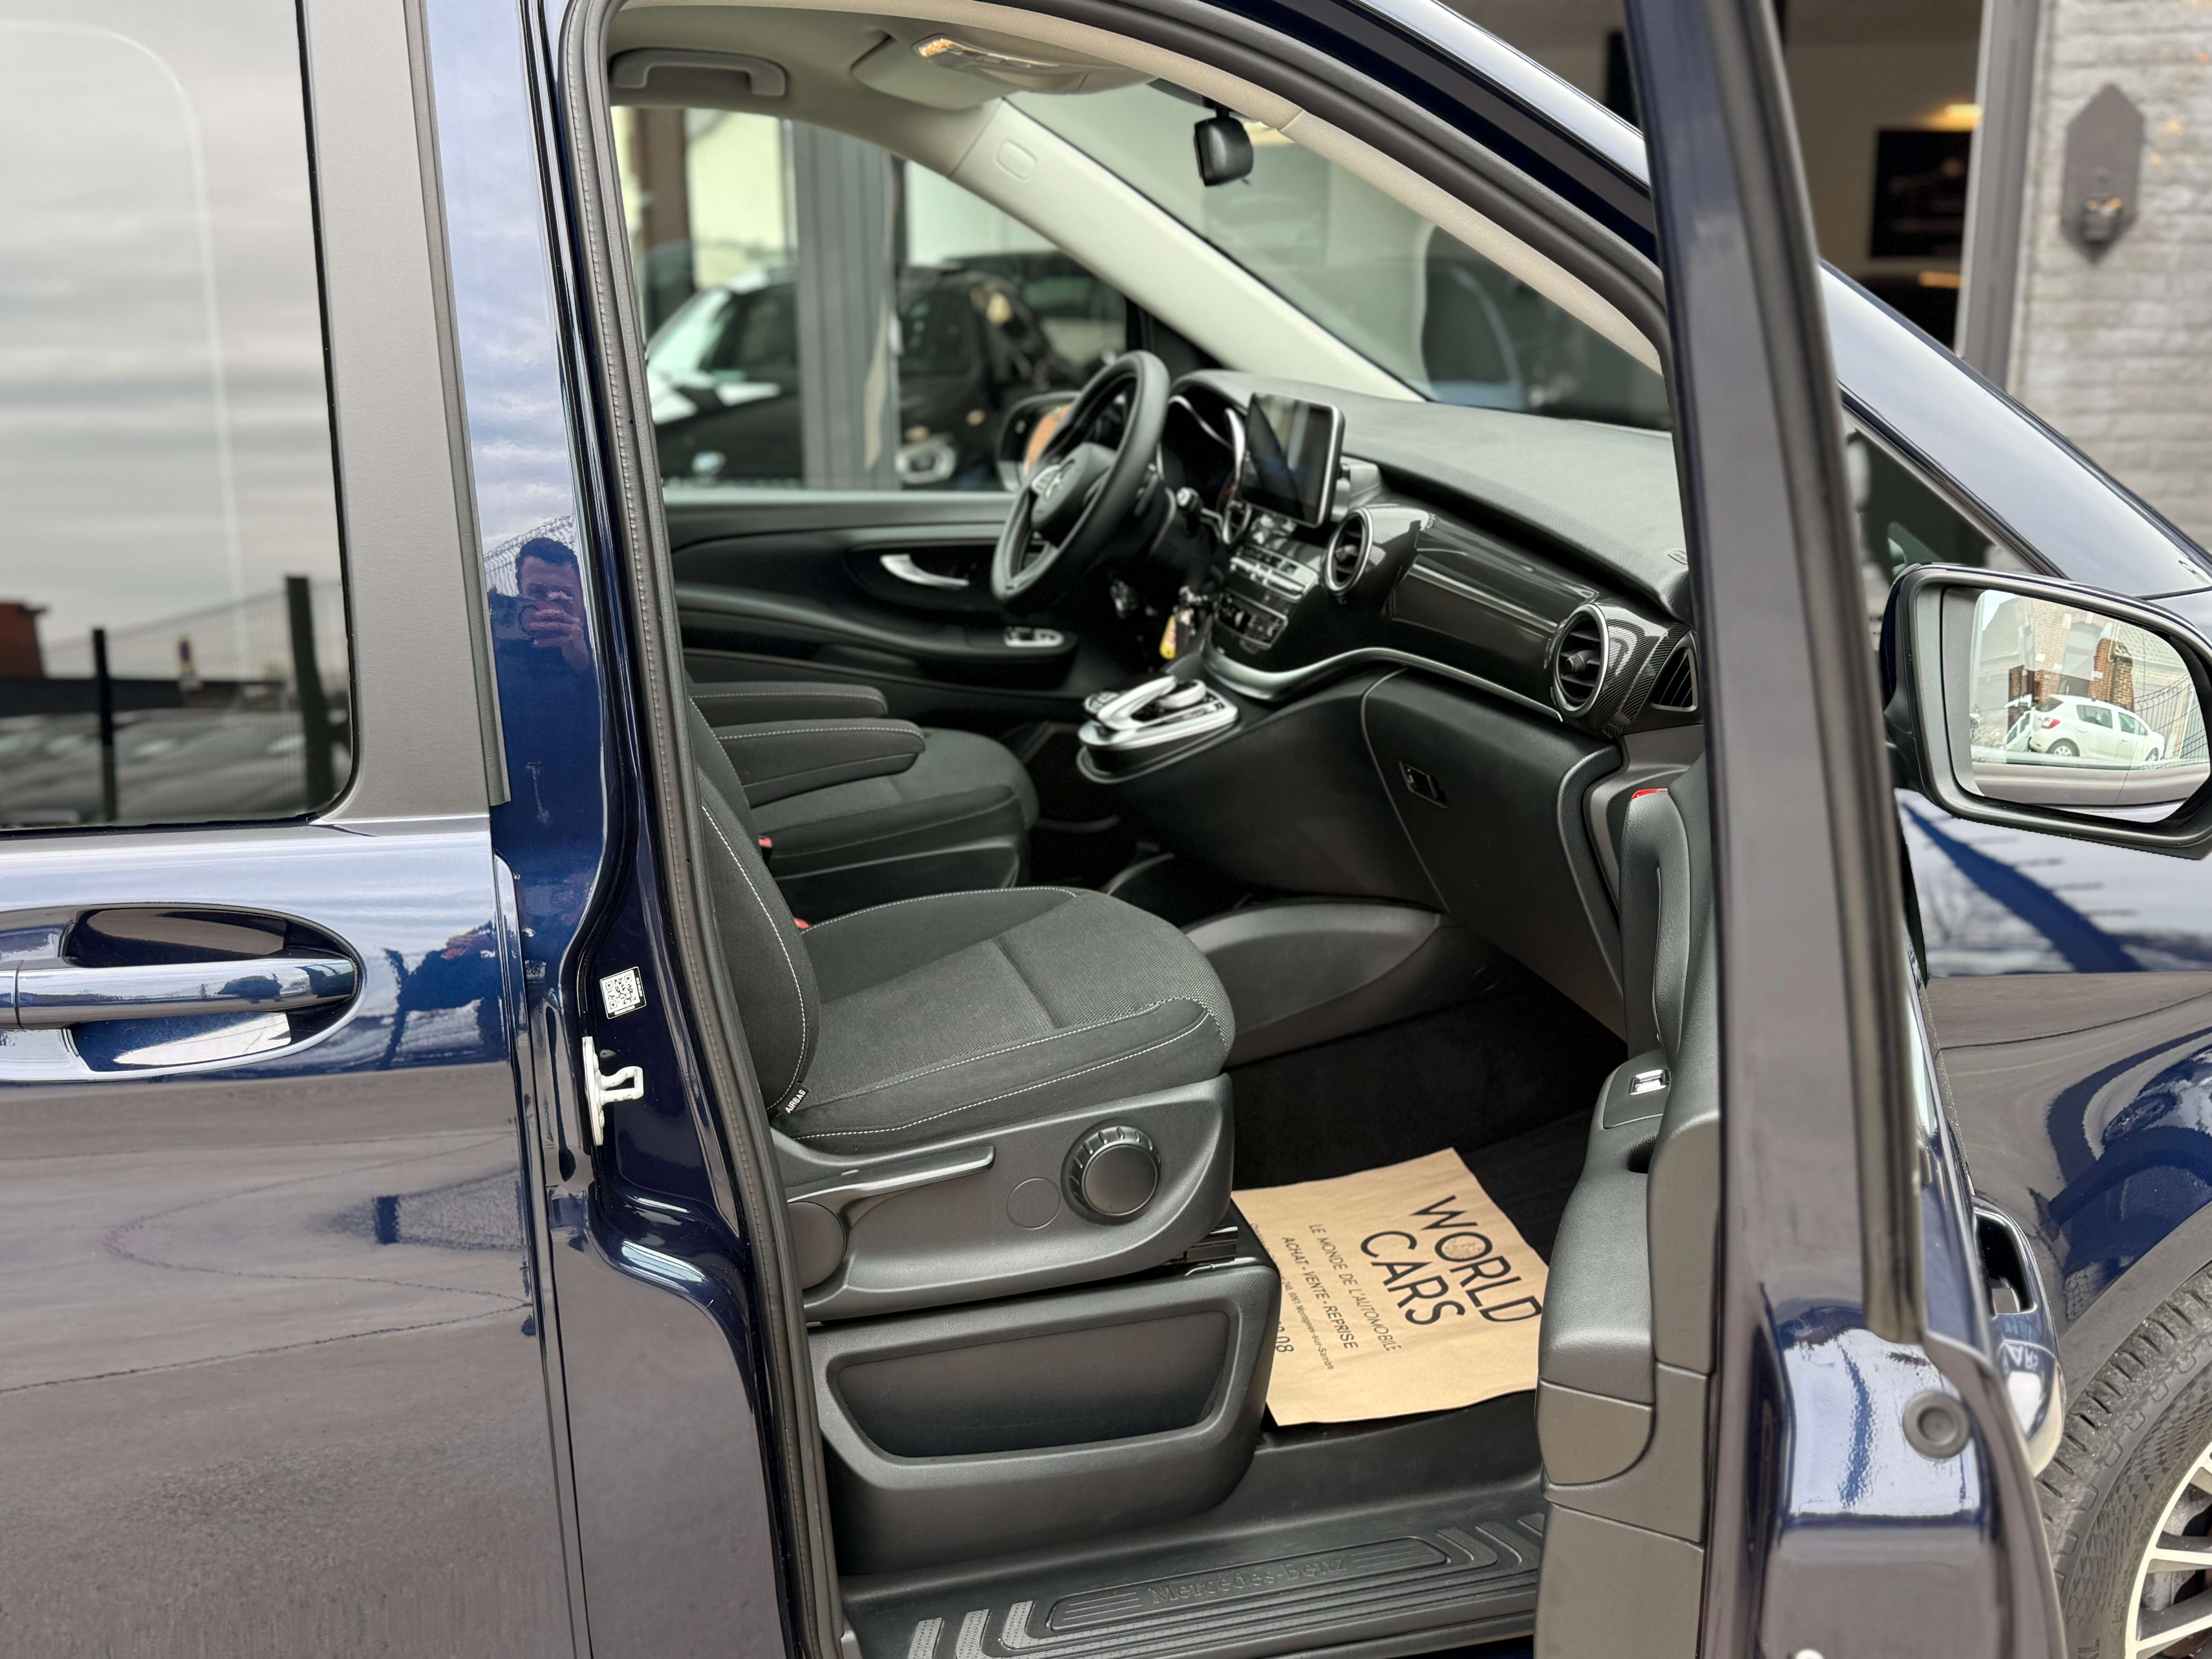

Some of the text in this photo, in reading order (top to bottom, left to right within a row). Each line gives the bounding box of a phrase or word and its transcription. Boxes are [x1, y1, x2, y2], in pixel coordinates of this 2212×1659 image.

[785, 1089, 806, 1113] AIRBAG
[1282, 1237, 1309, 1265] ACHAT
[1303, 1271, 1330, 1299] VENTE
[1323, 1306, 1359, 1349] REPRISE
[1309, 1224, 1402, 1351] LE MONDE DE L'AUTOMOBILE
[1360, 1231, 1465, 1325] CARS
[1408, 1195, 1542, 1322] WORLD
[1148, 1558, 1347, 1604] Mercedes-Benz
